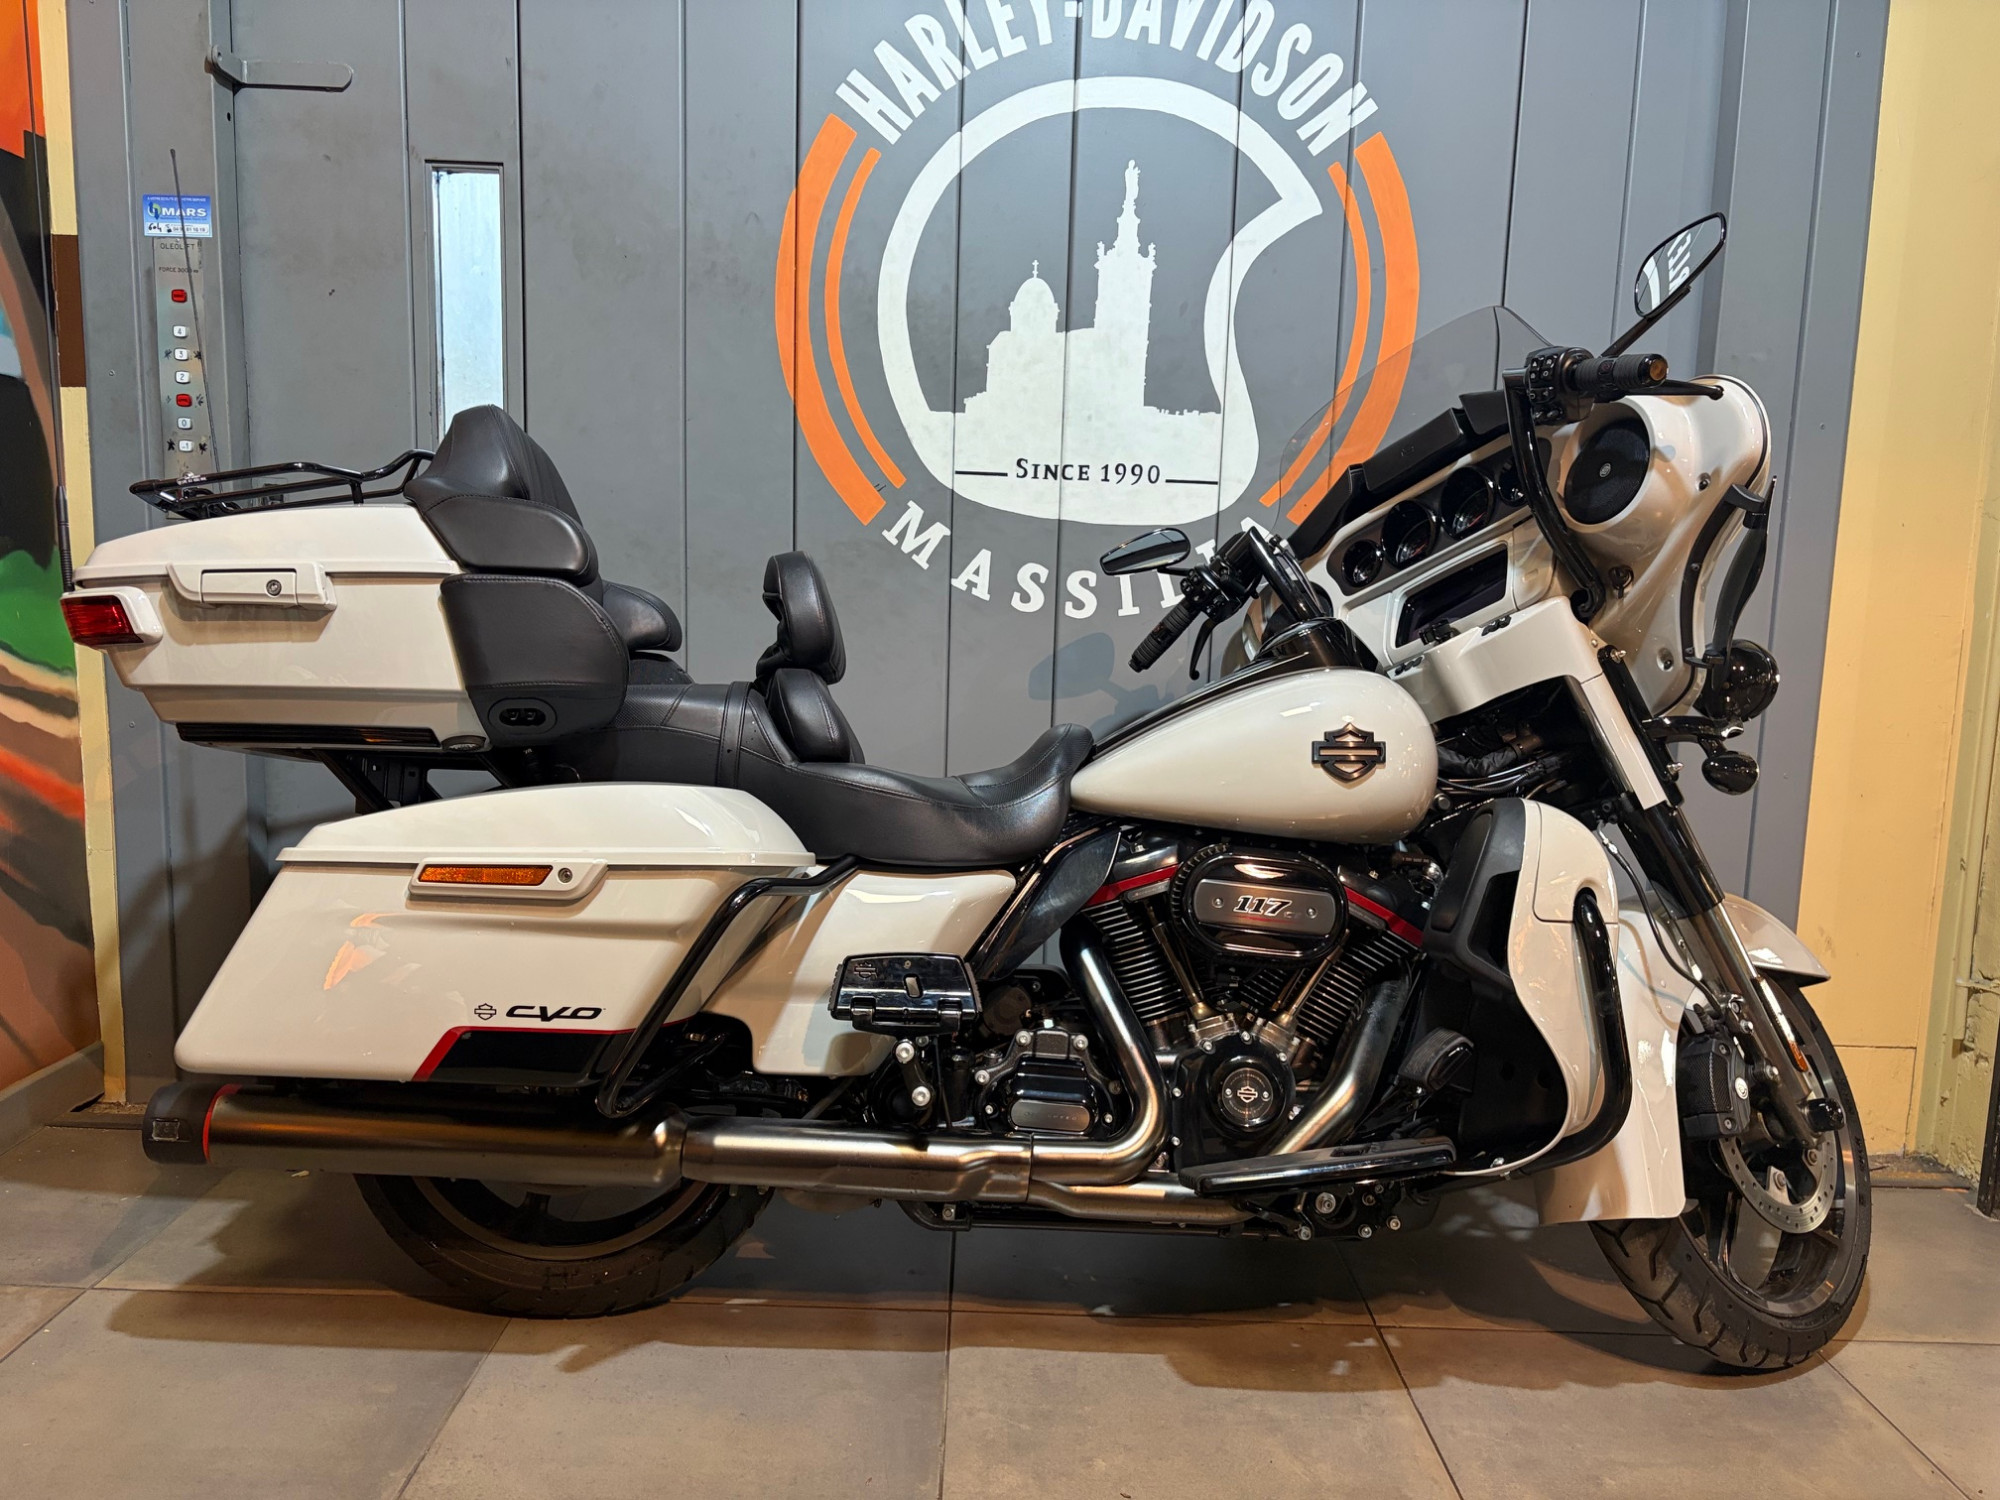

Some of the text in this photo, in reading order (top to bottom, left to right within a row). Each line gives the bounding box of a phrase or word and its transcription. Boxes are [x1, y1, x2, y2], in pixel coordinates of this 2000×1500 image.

[162, 207, 207, 217] MARS
[160, 242, 196, 250] OLEOLFT
[1100, 463, 1161, 486] 1990
[1233, 895, 1293, 917] 117
[505, 1005, 603, 1022] CVO
